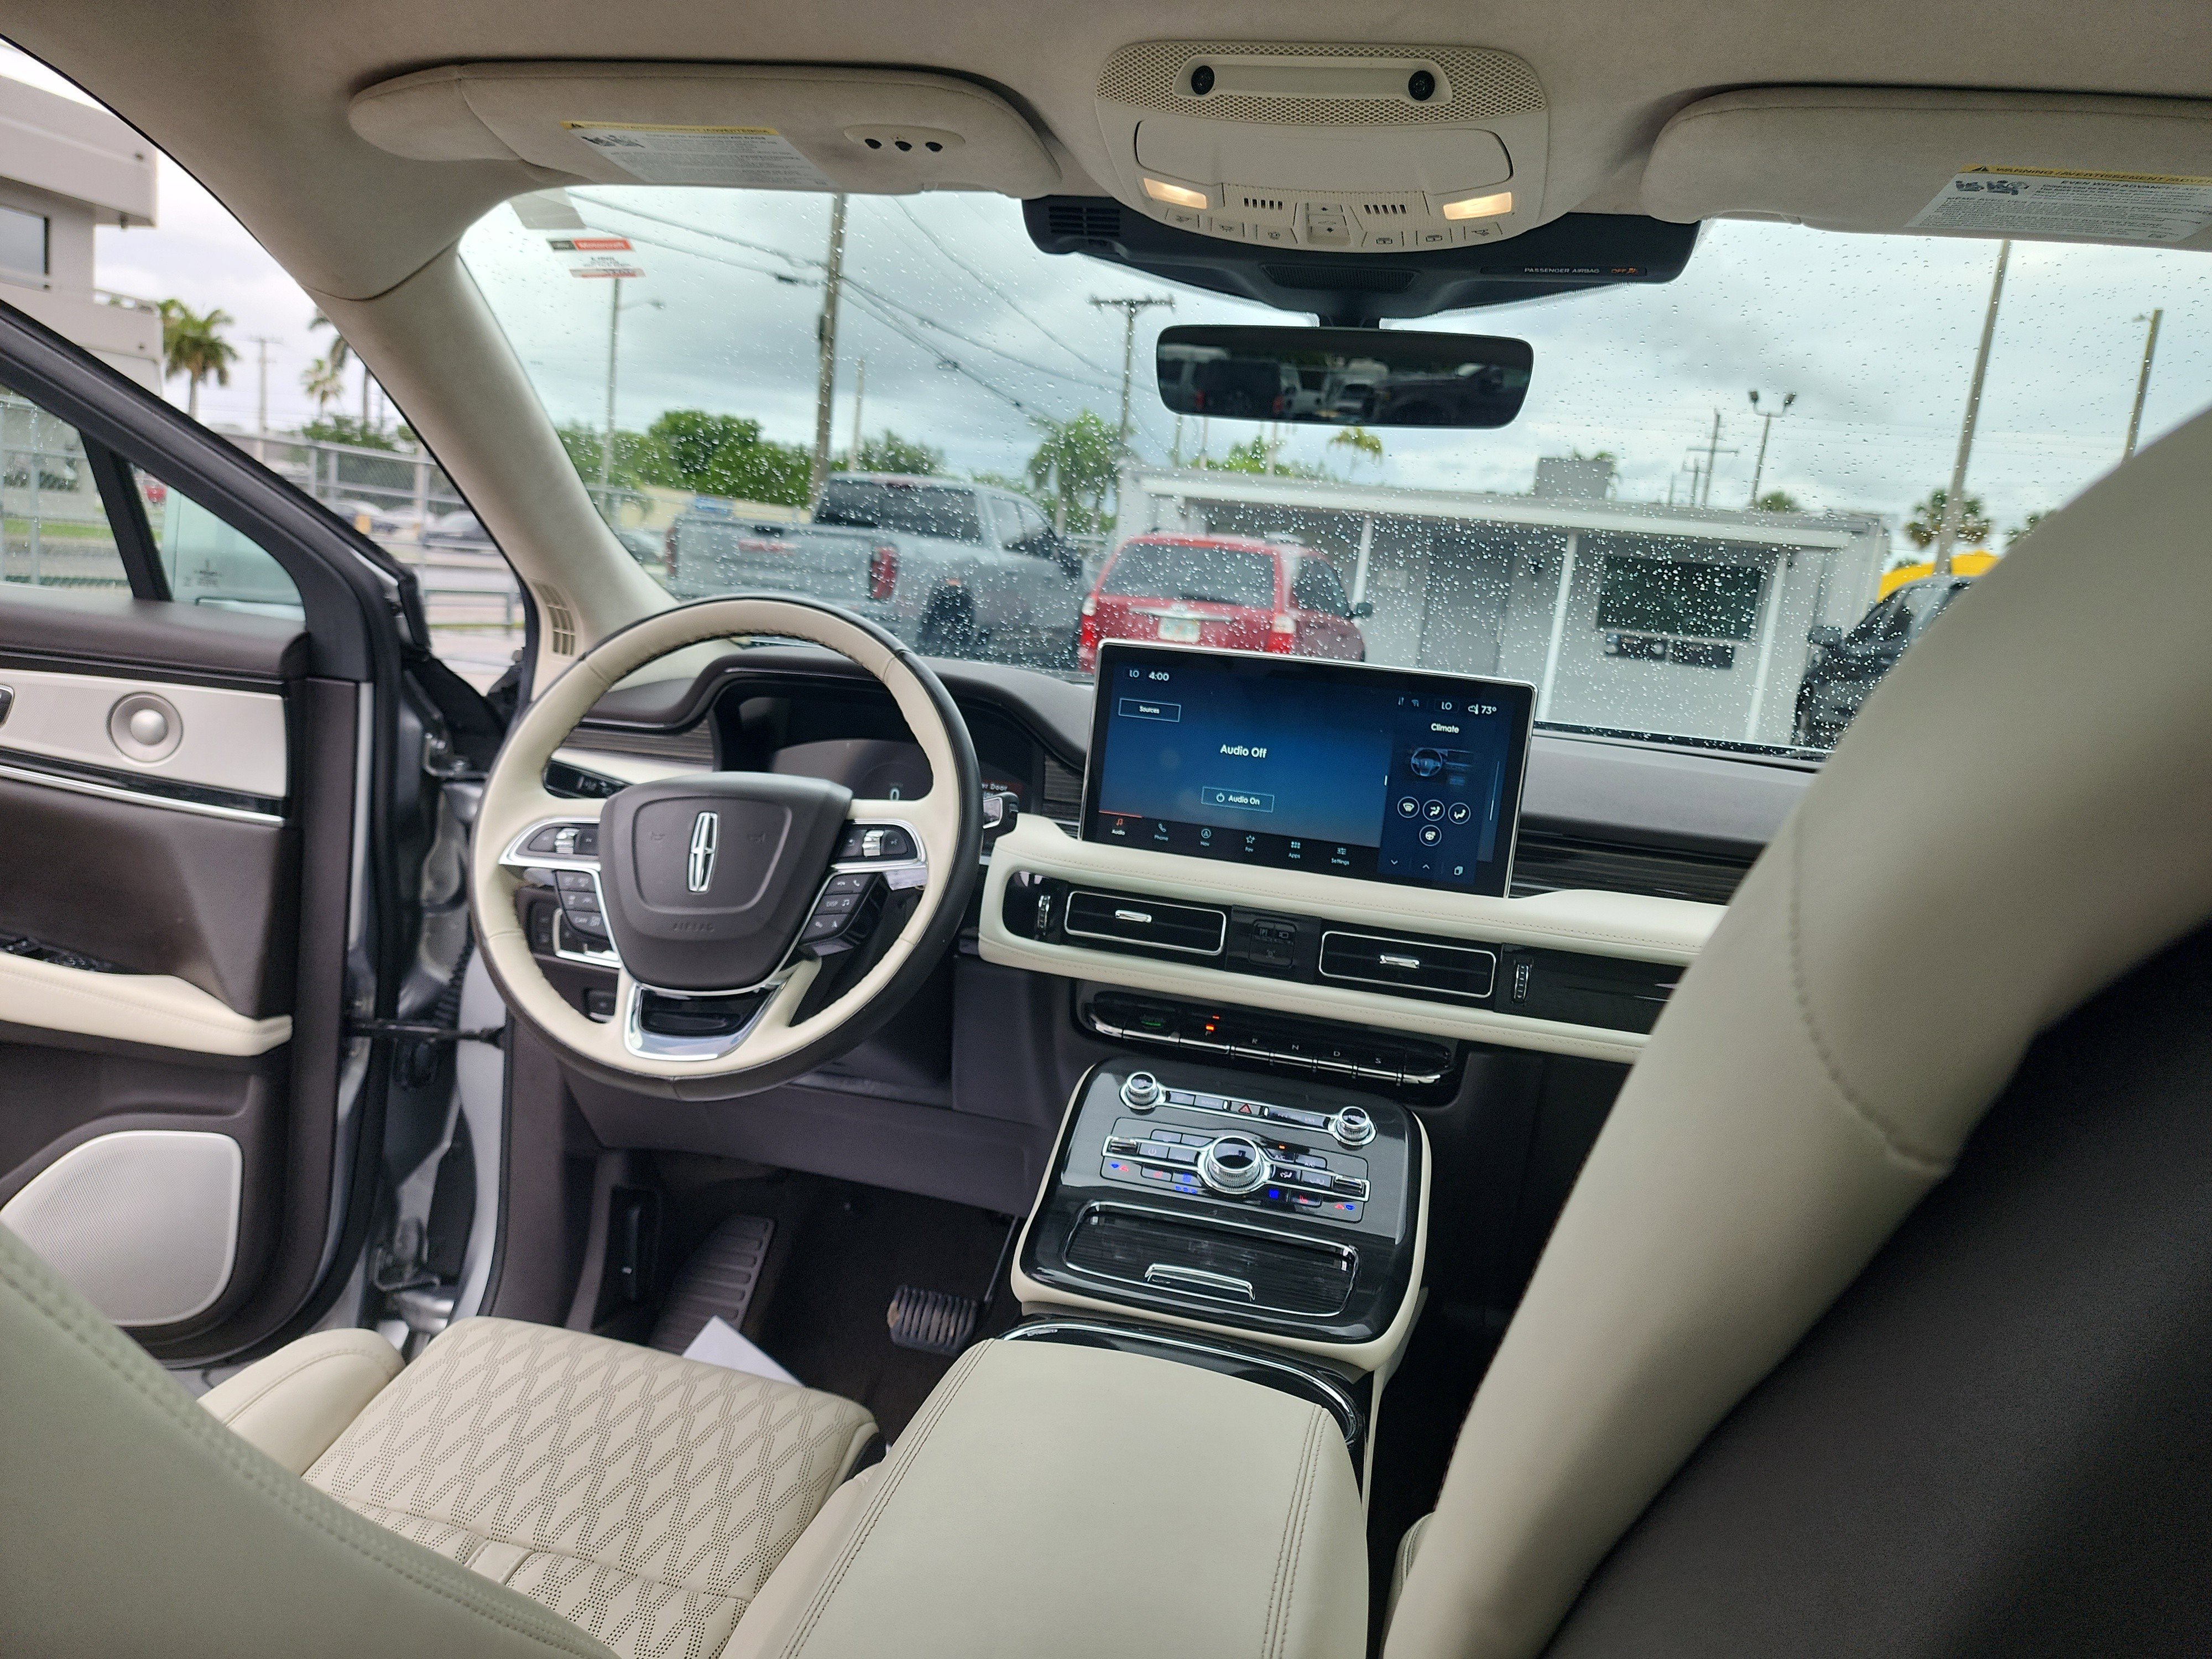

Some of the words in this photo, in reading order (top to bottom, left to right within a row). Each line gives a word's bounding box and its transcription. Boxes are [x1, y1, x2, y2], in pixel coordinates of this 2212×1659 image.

[1148, 671, 1170, 681] 4:00
[1139, 705, 1160, 714] Sources
[1441, 701, 1452, 711] LO
[1431, 723, 1459, 733] Climate
[1220, 744, 1249, 757] Audio
[1251, 747, 1267, 758] Off
[1228, 795, 1249, 804] Audio
[1249, 796, 1261, 806] On
[1154, 833, 1168, 842] Phone
[1331, 857, 1350, 866] Settings
